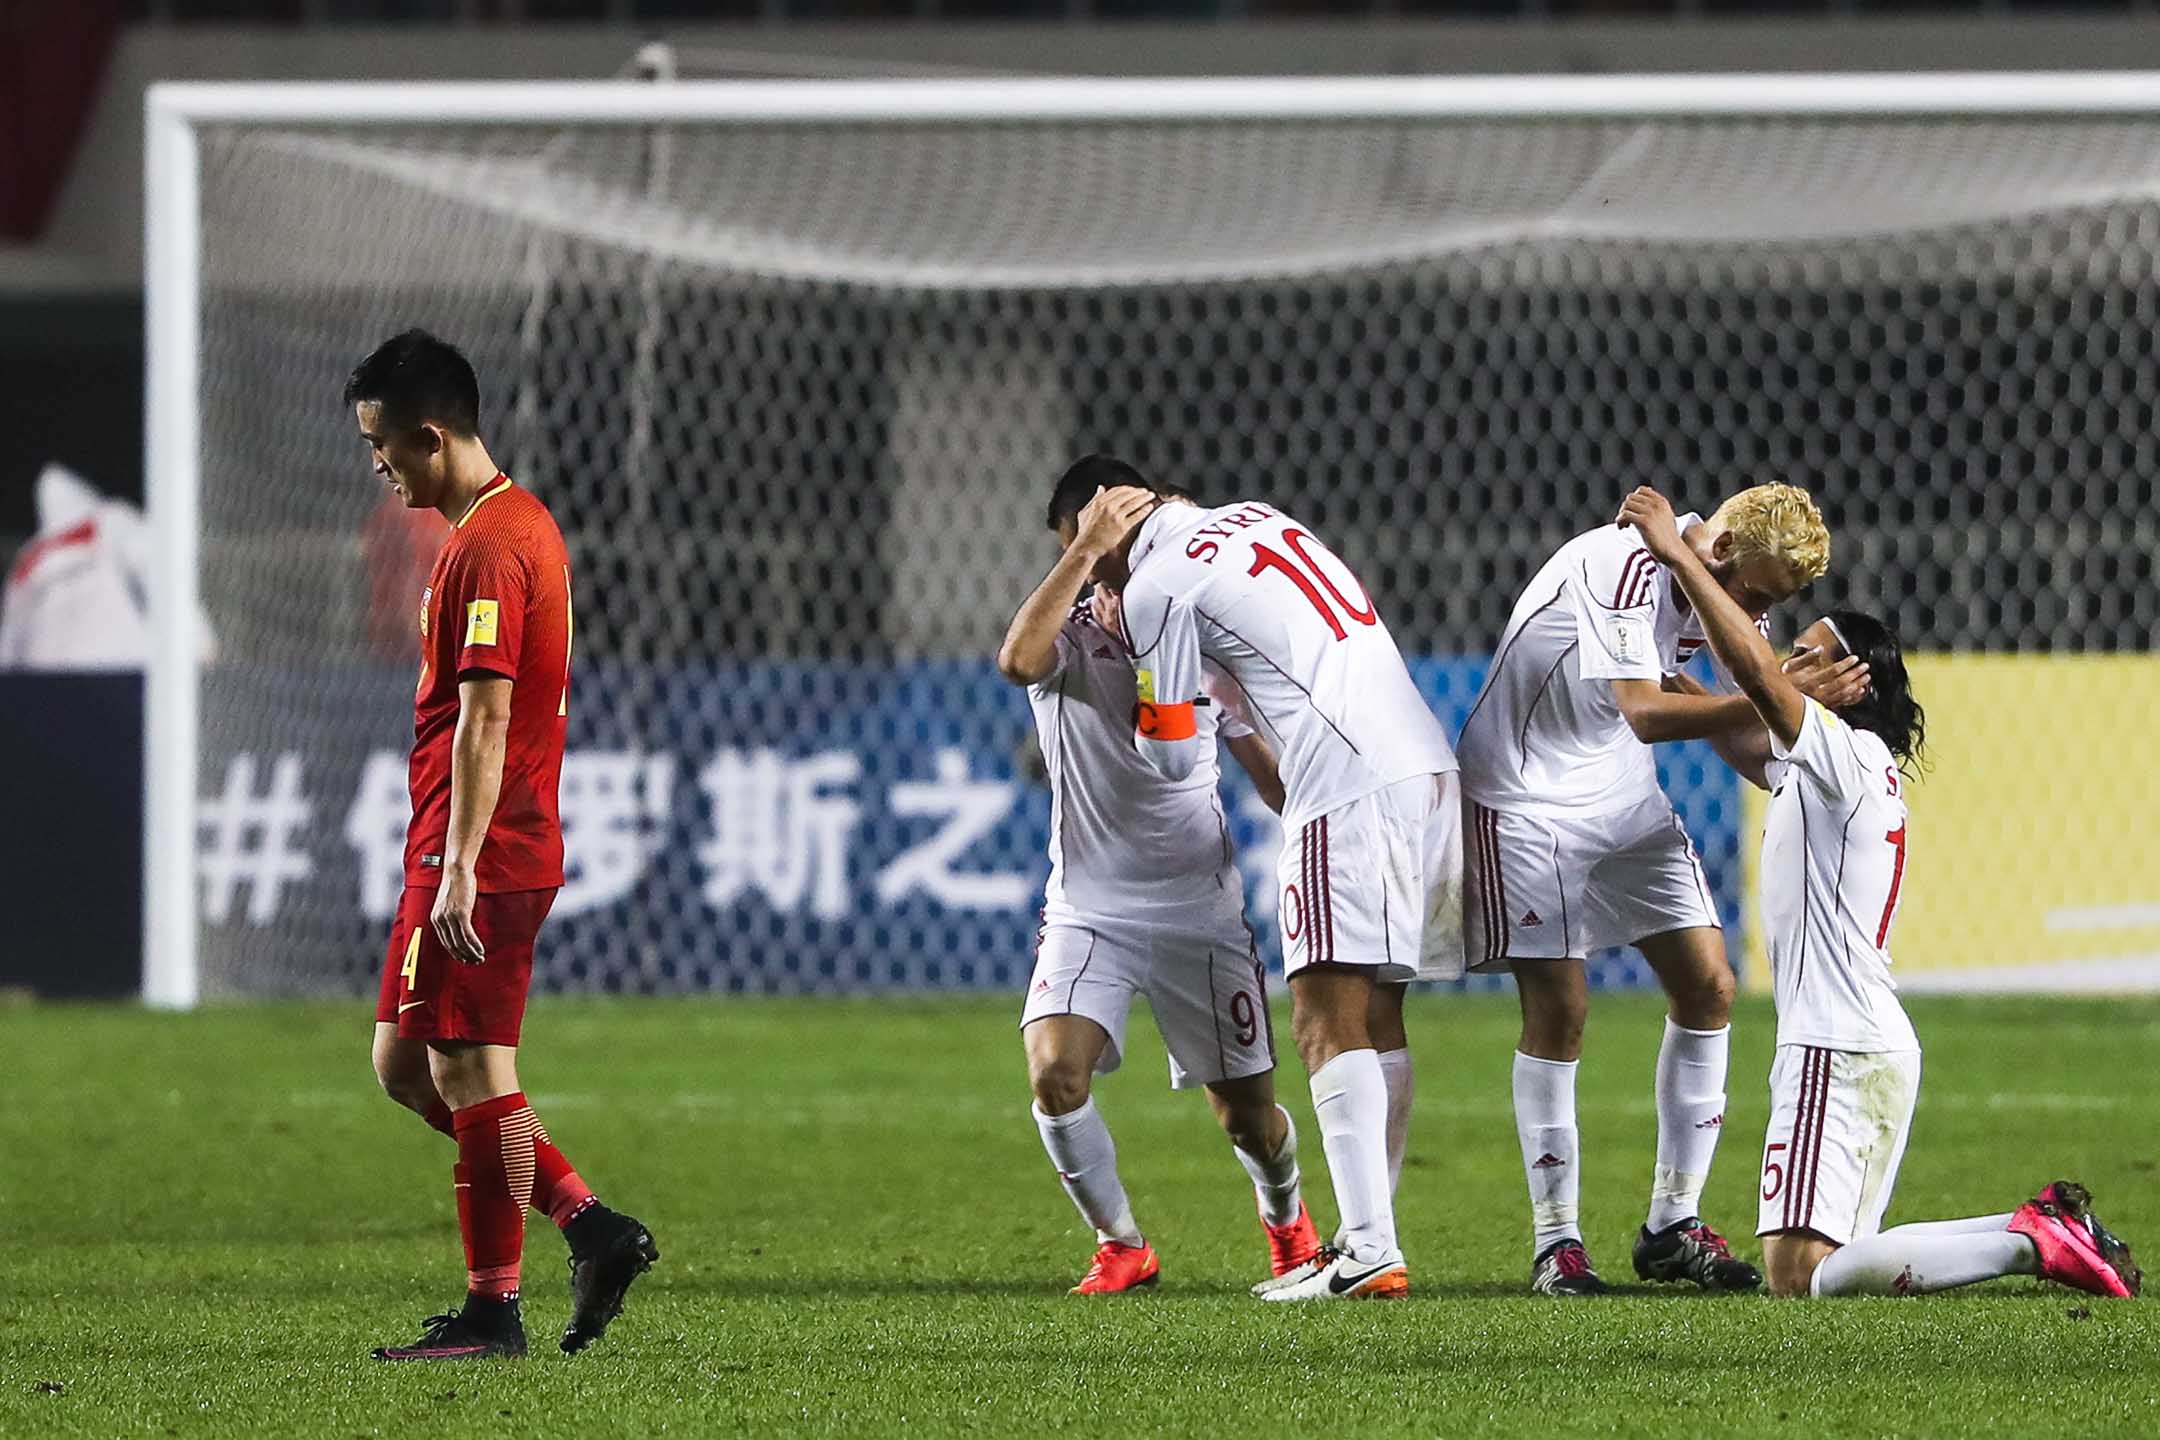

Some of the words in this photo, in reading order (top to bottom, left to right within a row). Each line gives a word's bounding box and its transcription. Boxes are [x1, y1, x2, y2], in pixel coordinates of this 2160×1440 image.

[1186, 506, 1272, 564] SYRI
[1247, 529, 1375, 642] 10
[1132, 702, 1158, 735] C
[400, 926, 422, 991] 4
[1230, 990, 1258, 1047] 9
[1762, 1143, 1787, 1201] 5
